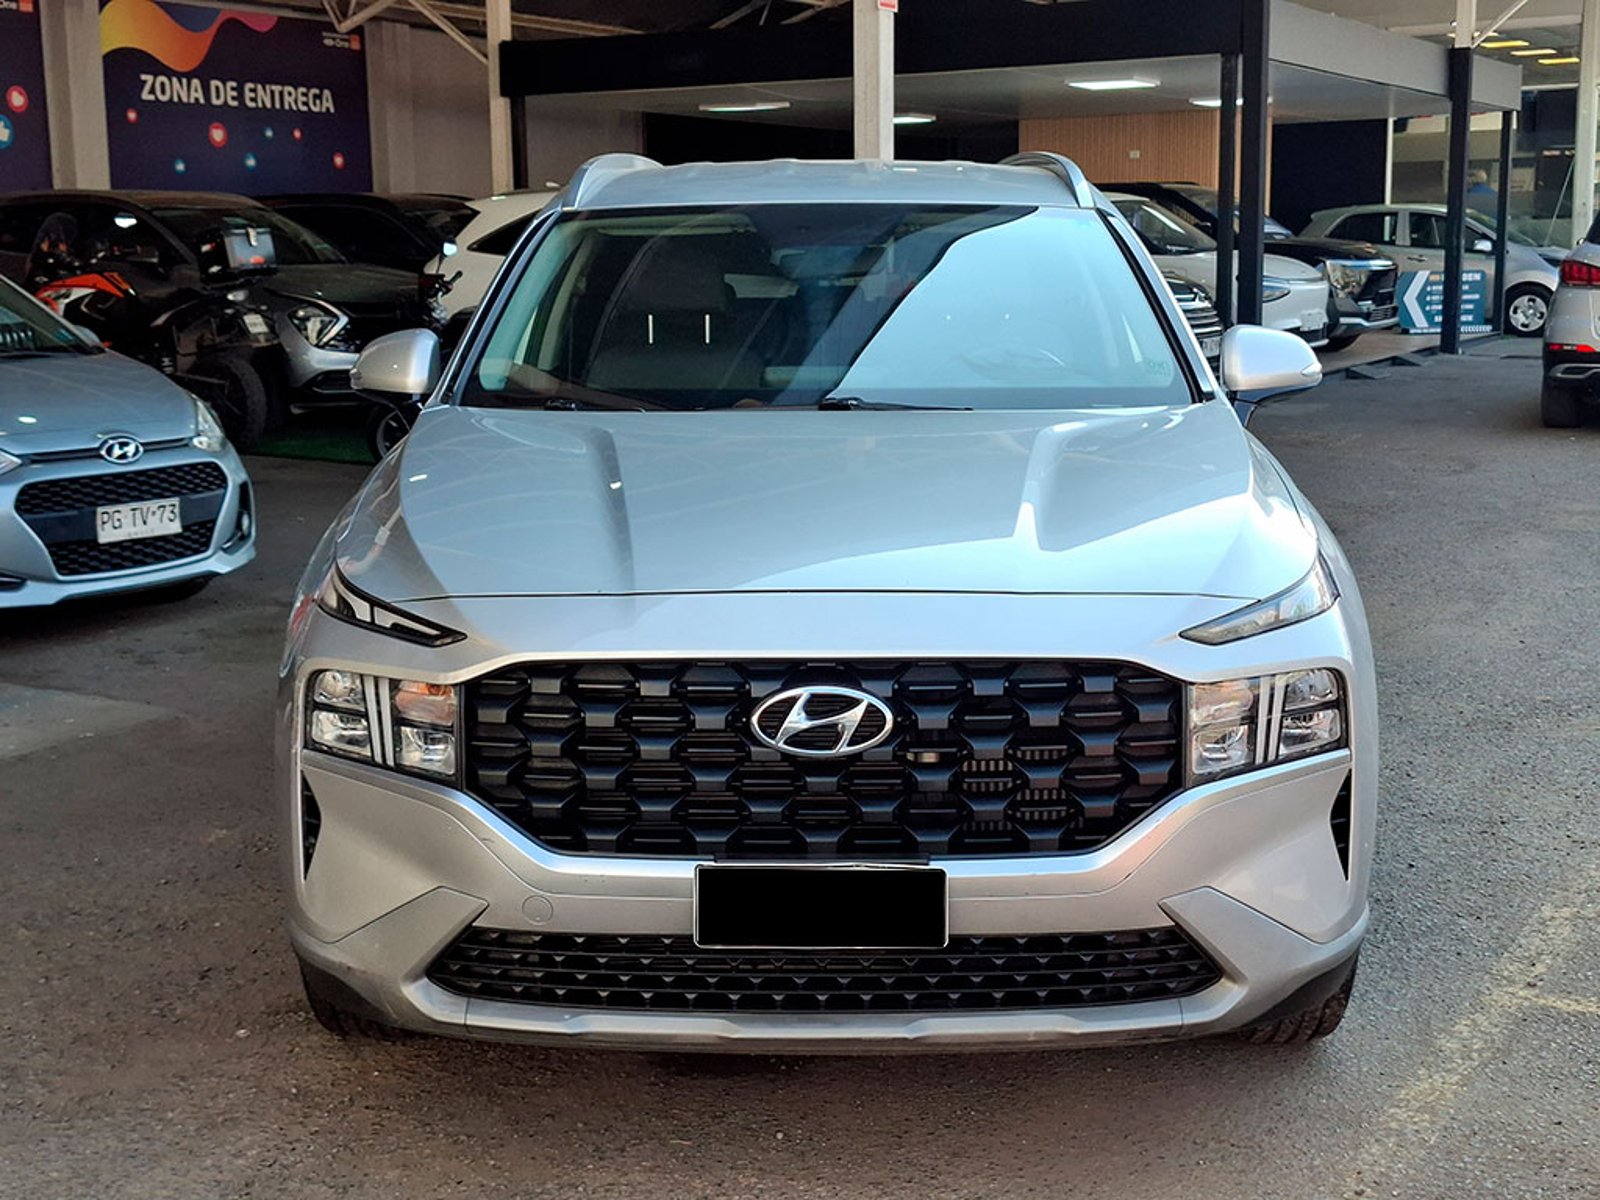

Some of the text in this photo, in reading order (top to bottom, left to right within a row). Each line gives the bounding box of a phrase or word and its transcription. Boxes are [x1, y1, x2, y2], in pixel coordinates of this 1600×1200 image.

[140, 73, 335, 113] ZONA DE ENTREGA
[100, 510, 122, 532] PG
